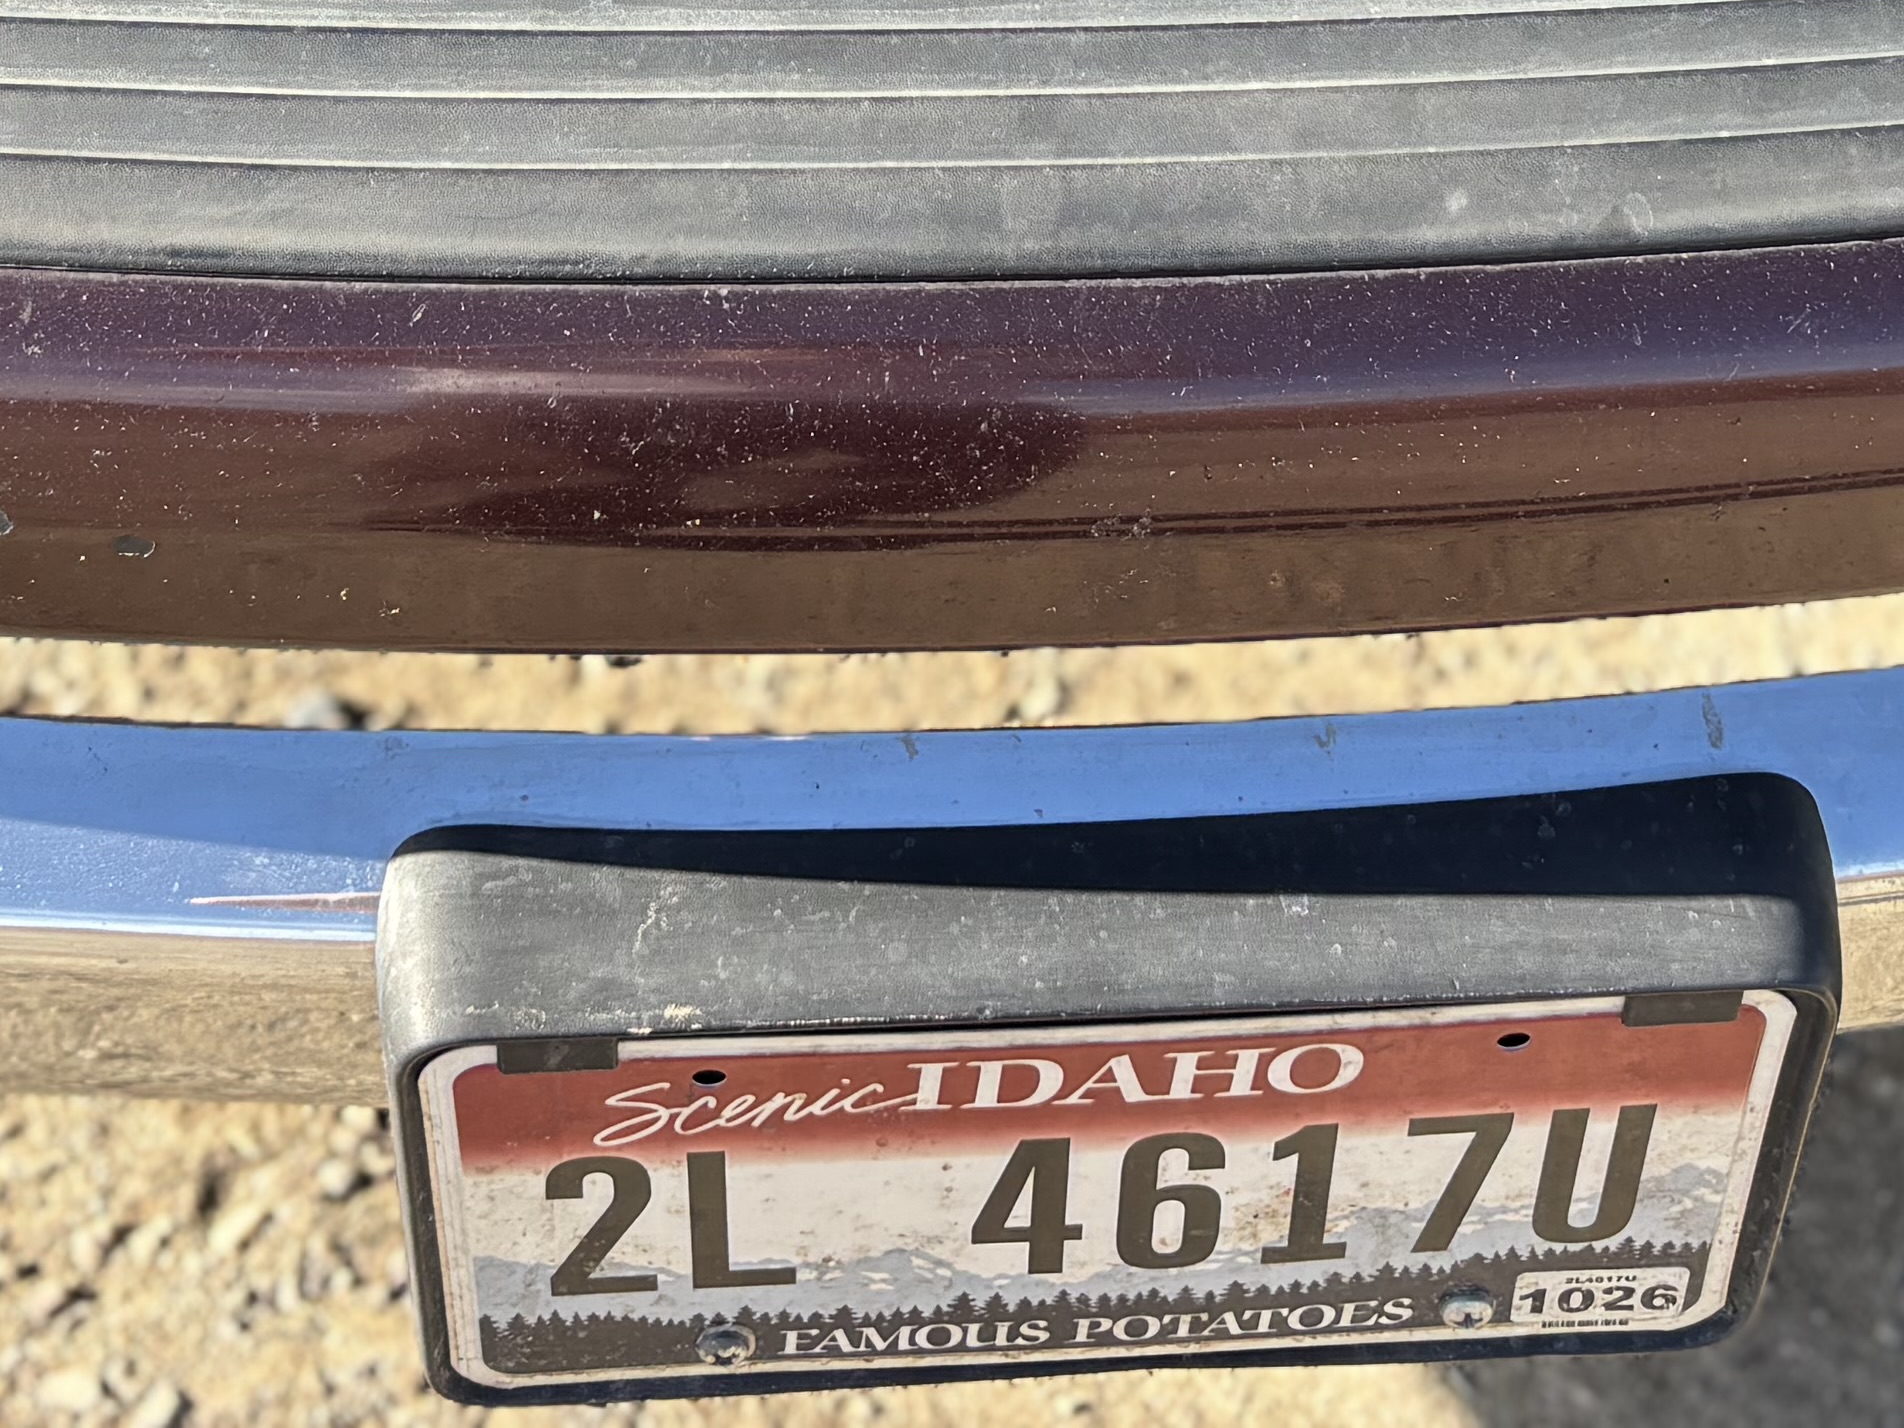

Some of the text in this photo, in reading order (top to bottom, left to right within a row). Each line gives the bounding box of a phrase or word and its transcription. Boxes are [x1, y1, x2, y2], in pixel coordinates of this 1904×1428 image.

[593, 1041, 1365, 1146] Scenic IDAHO
[542, 1104, 1660, 1299] 2L 4617U
[777, 1297, 1415, 1356] FAMOUS POTATOES
[1518, 1284, 1678, 1314] 1026
